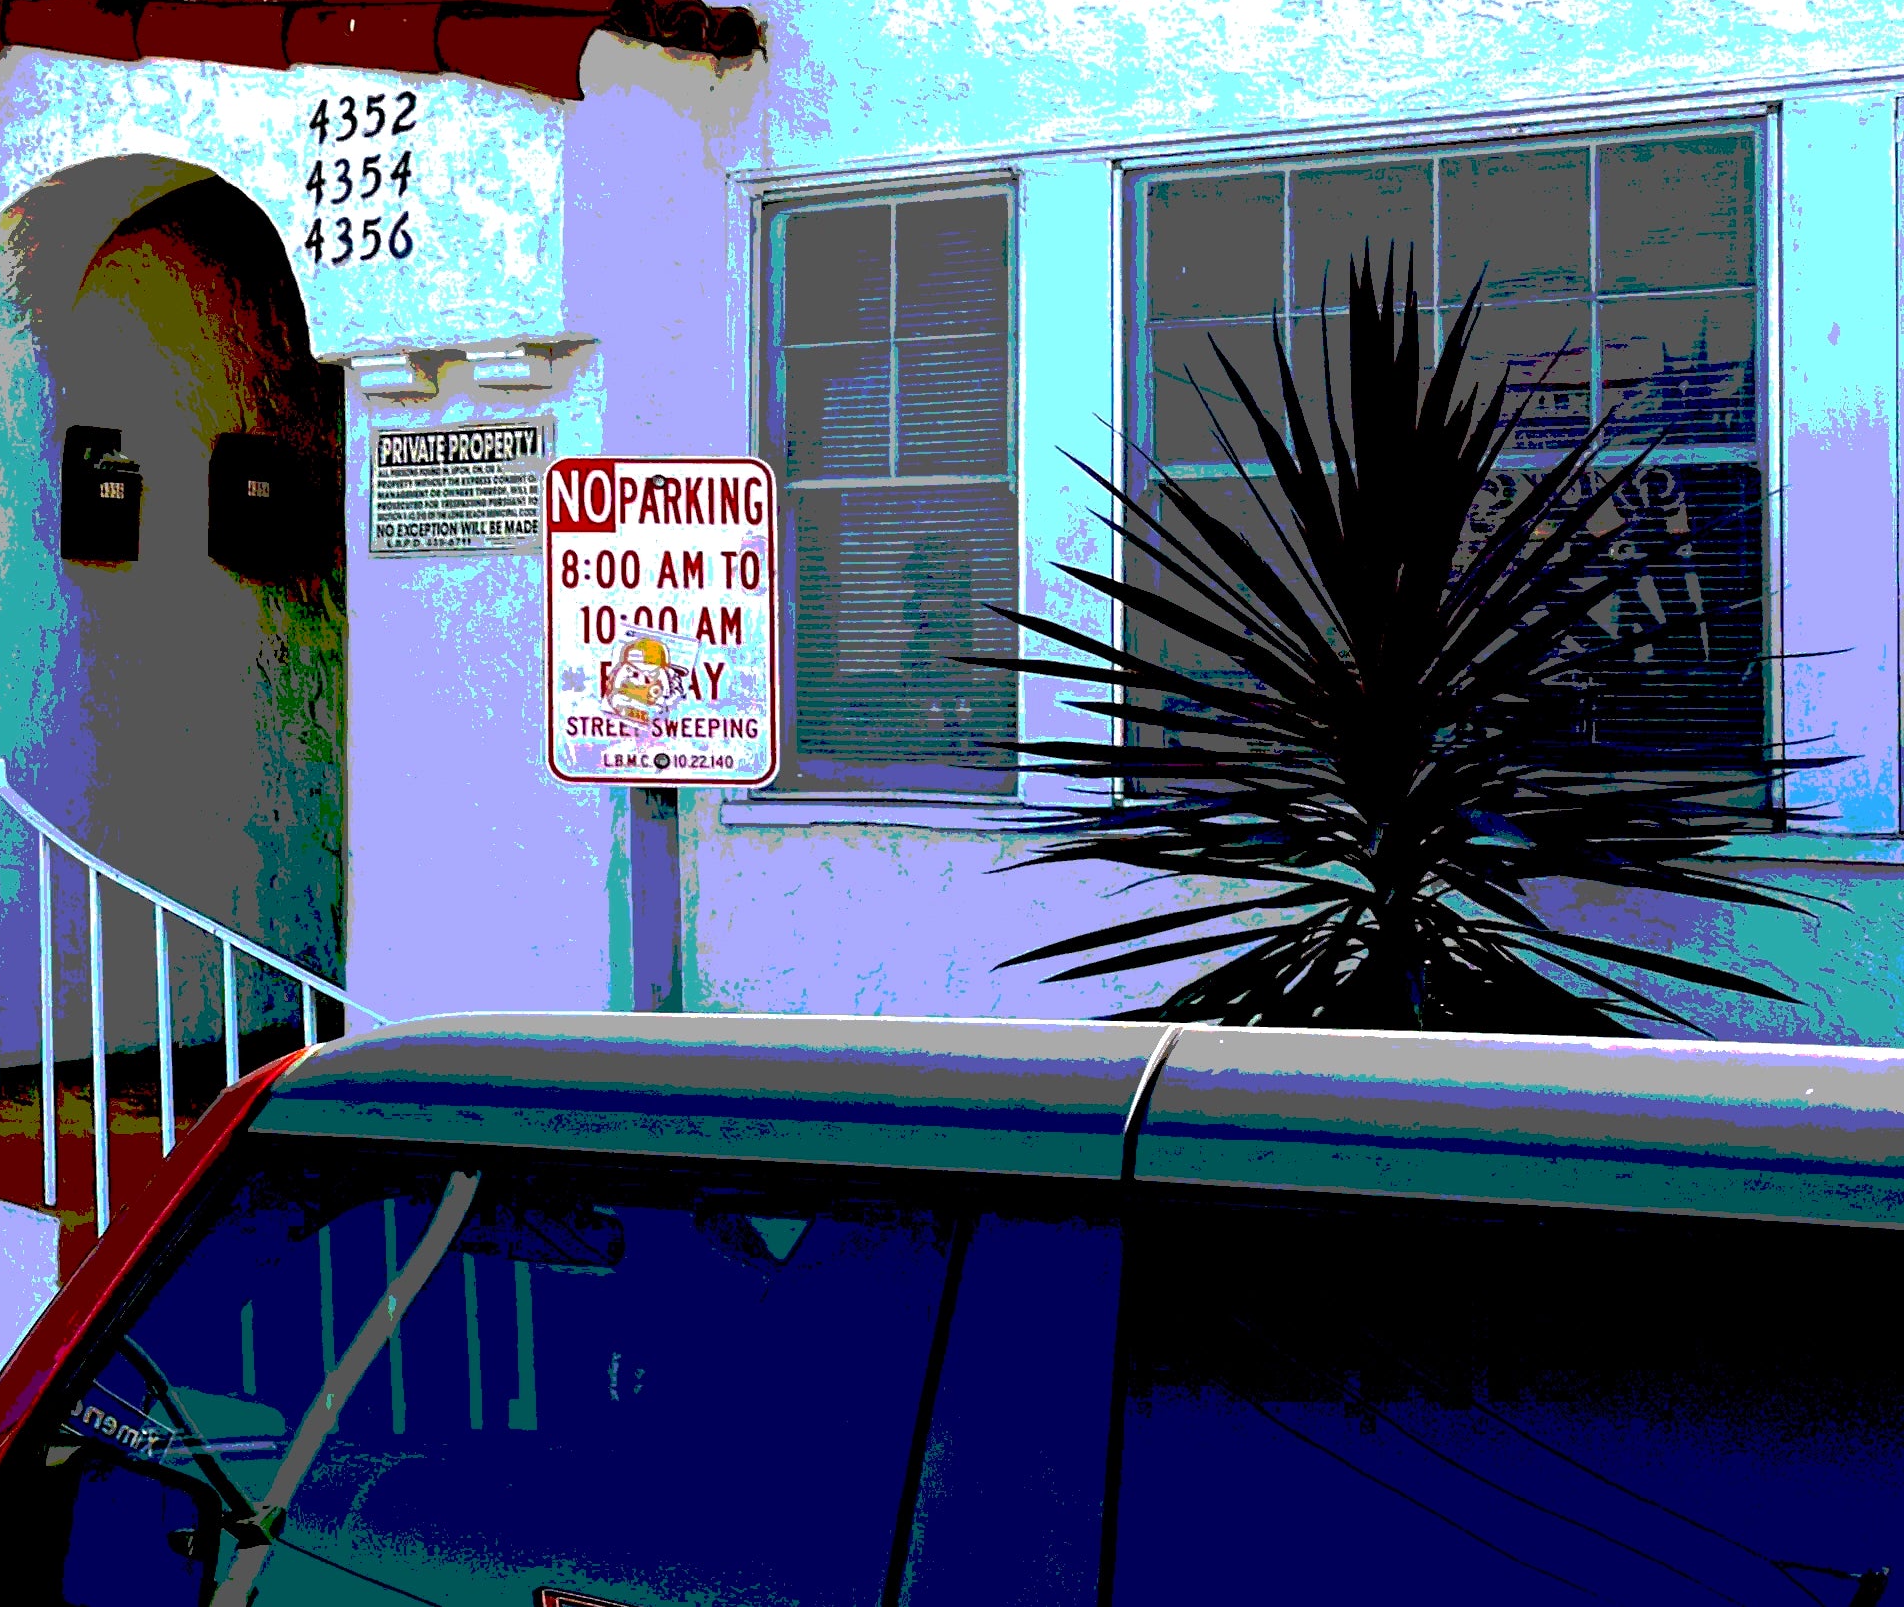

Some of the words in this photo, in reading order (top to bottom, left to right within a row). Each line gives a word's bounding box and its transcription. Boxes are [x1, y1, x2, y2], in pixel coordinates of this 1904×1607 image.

[309, 91, 417, 144] 4352
[305, 150, 412, 206] 4354
[304, 210, 413, 266] 4356
[381, 435, 445, 465] PRIVATE
[448, 430, 534, 462] PROPERTY
[551, 470, 612, 523] NO
[619, 476, 763, 525] PARKING
[377, 523, 395, 538] NO
[397, 522, 458, 537] EXCEPTION
[461, 521, 487, 536] WILL
[489, 520, 503, 534] BE
[504, 519, 539, 534] MADE
[561, 549, 640, 589] 8:00
[657, 550, 704, 589] AM
[720, 550, 760, 590] TO
[695, 606, 742, 645] AM
[651, 717, 759, 740] SWEEPING
